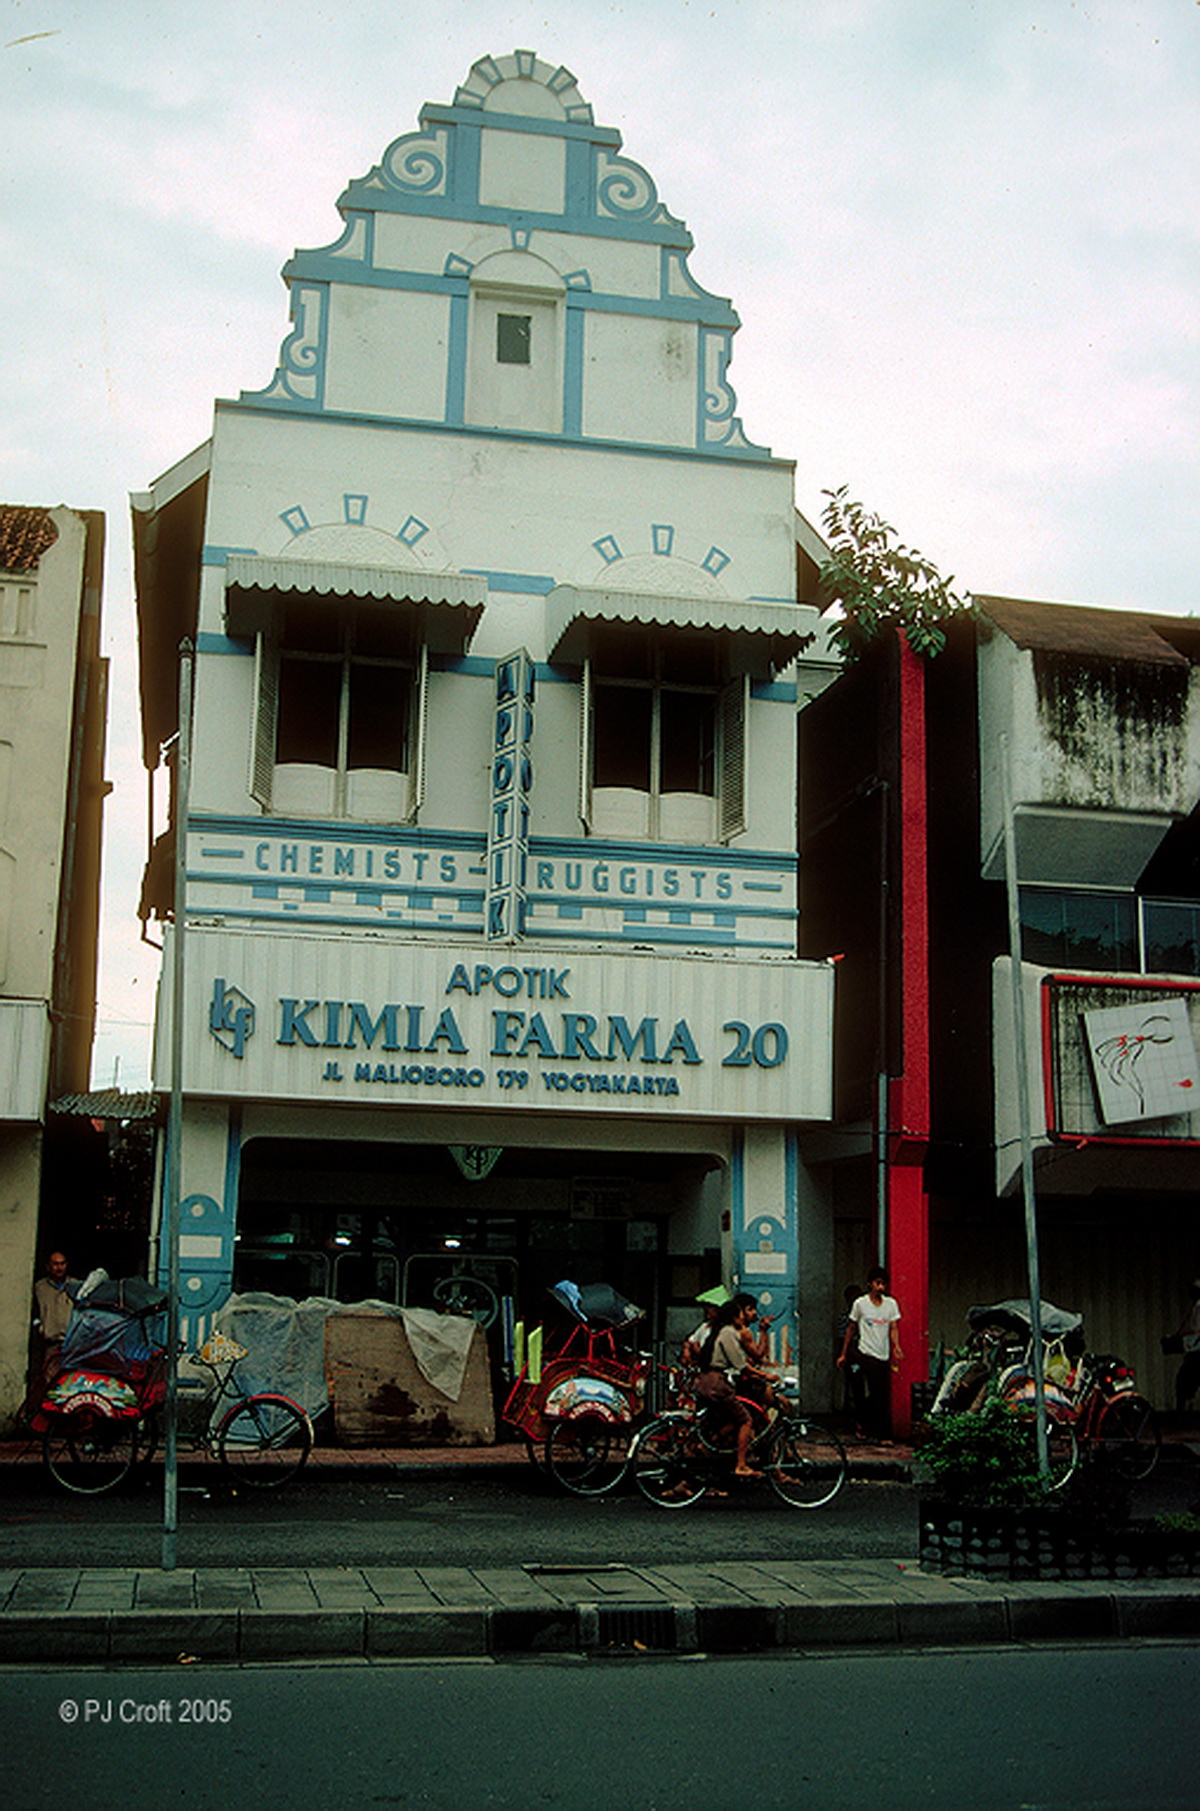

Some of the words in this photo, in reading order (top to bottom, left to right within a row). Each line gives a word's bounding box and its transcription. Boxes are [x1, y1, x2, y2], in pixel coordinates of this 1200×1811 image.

[255, 843, 458, 882] CHEMISTS
[537, 862, 734, 899] RUGGISTS
[445, 963, 571, 999] APOTIK
[276, 998, 469, 1054] KIMIA
[490, 1010, 704, 1065] FARMA
[721, 1021, 789, 1068] 20
[322, 1062, 344, 1081] JL
[354, 1062, 485, 1088] MALIOBORO
[497, 1070, 529, 1090] 179
[541, 1072, 680, 1096] YOGYAKARTA
